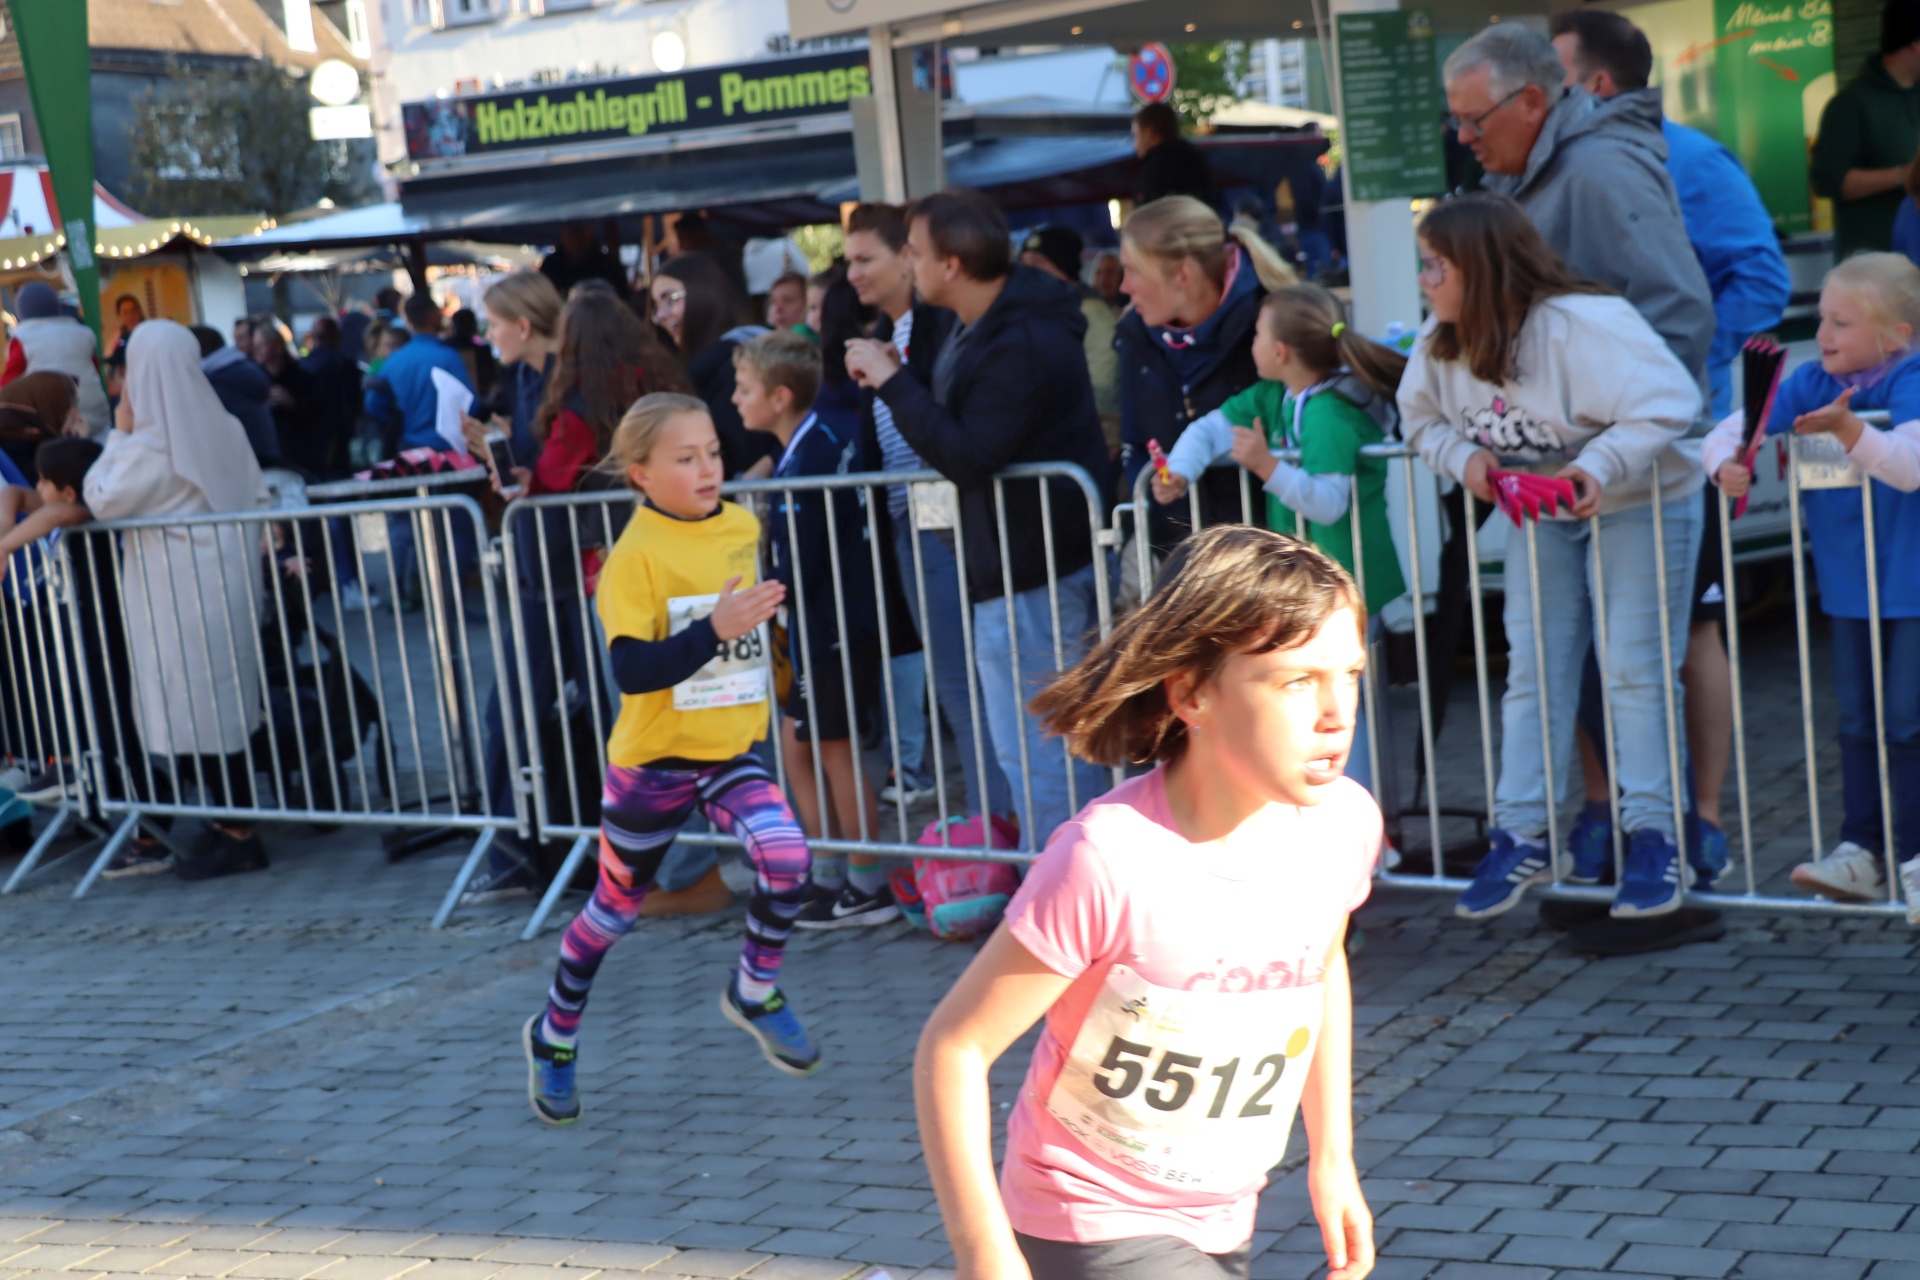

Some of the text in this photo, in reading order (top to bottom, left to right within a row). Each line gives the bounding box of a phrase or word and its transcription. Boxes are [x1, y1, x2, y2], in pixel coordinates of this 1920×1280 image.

[1725, 2, 1793, 31] Meine
[476, 80, 688, 144] Holzkohlegrill
[720, 65, 871, 117] Pommes
[1093, 1034, 1286, 1118] 5512
[1109, 1148, 1160, 1176] VOSS
